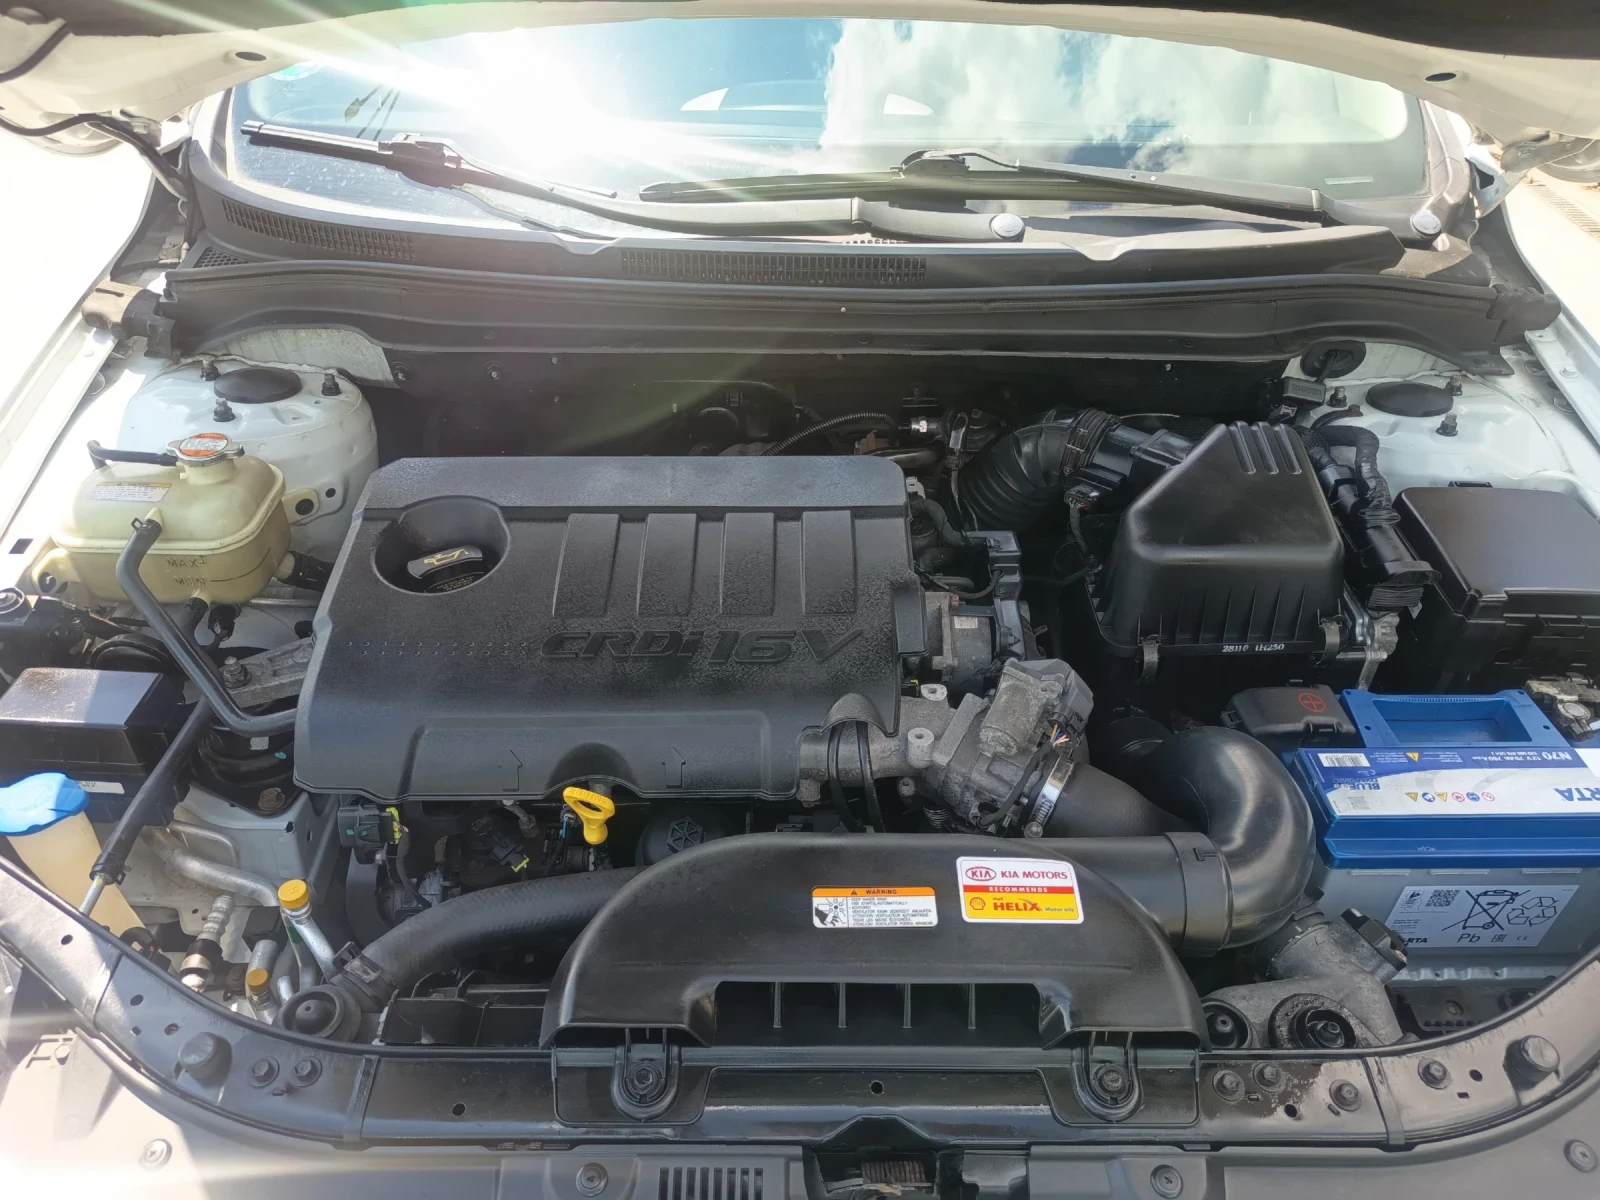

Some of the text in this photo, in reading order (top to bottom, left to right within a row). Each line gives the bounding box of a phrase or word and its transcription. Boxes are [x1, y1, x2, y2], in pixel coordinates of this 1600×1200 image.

[173, 576, 207, 586] MIN
[708, 629, 864, 663] 16V
[1541, 751, 1572, 761] N70
[567, 787, 606, 805] ENGINE
[970, 870, 992, 878] KIA
[1001, 870, 1068, 880] KIA MOTORS
[993, 900, 1042, 911] HELIX
[1456, 932, 1482, 944] Pb
